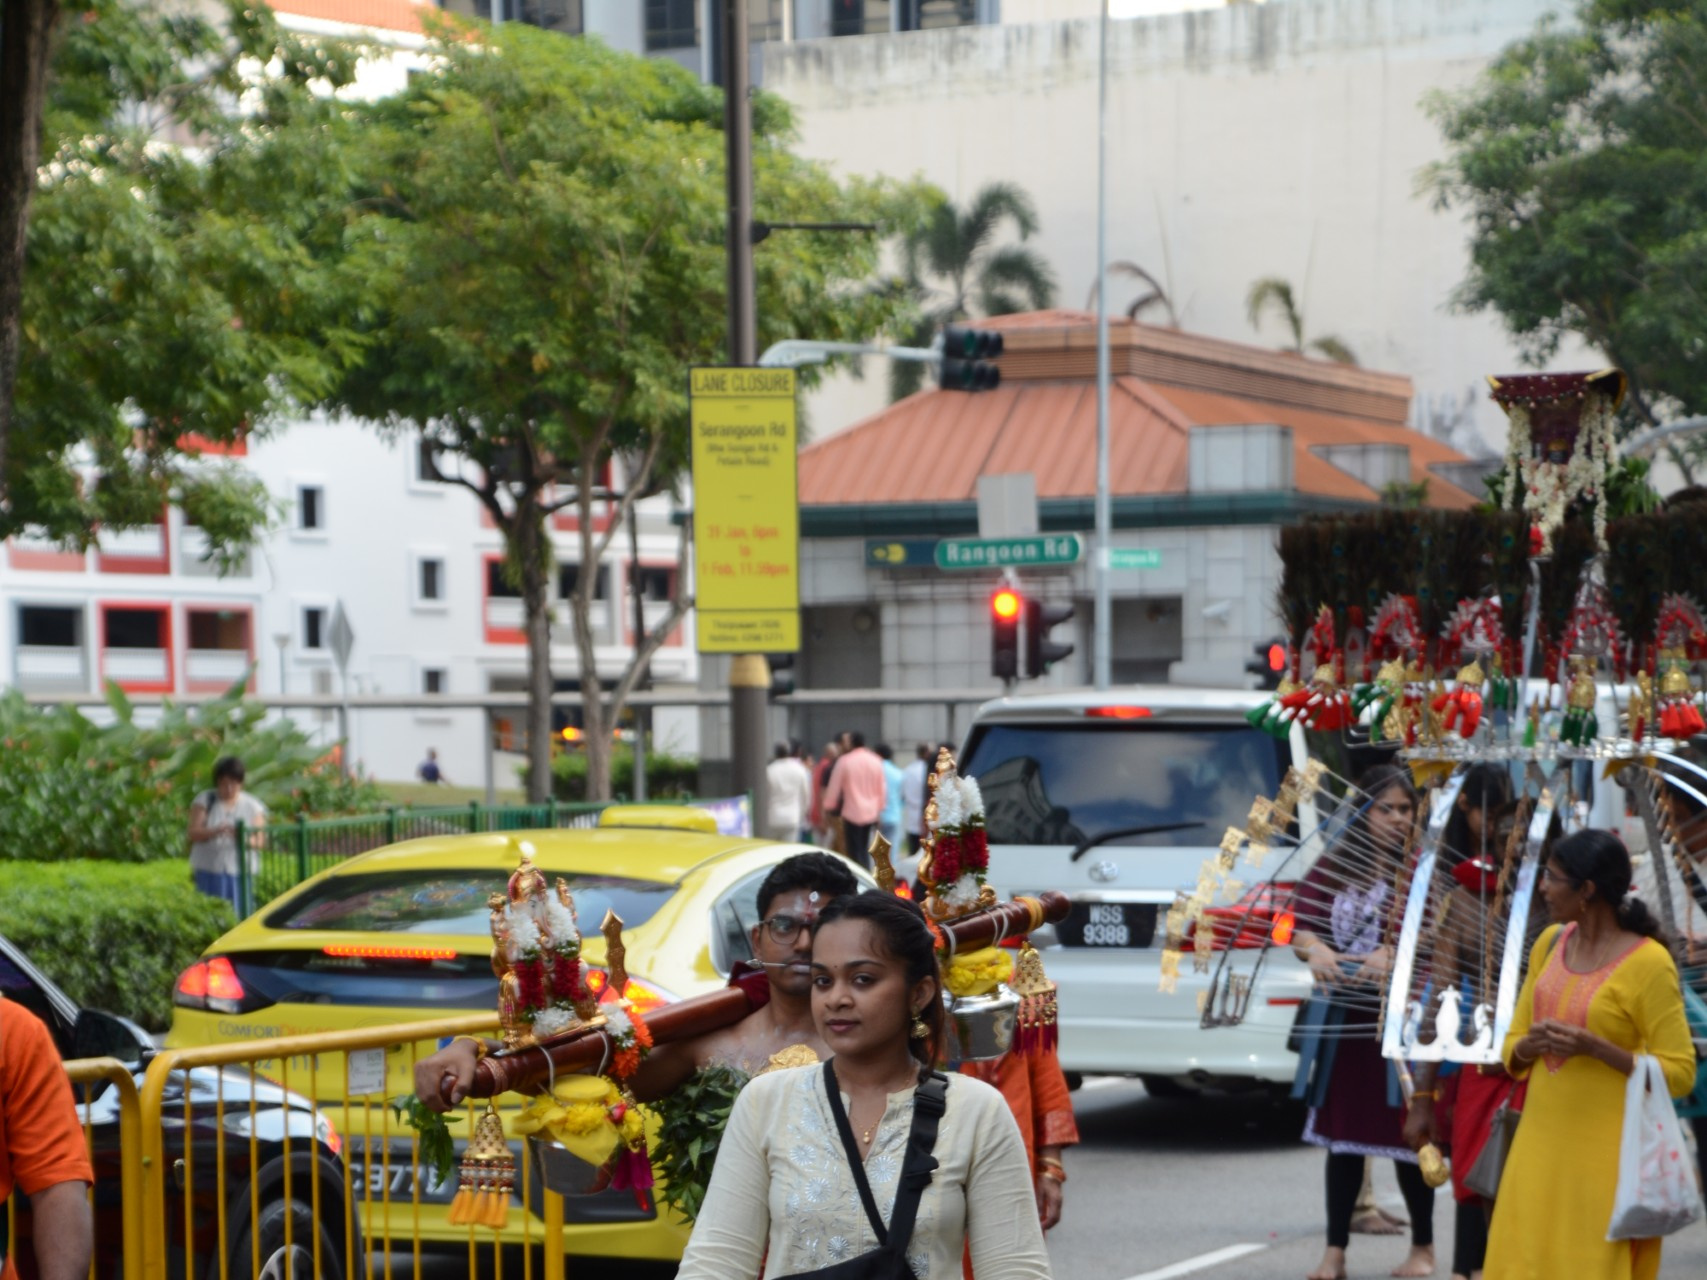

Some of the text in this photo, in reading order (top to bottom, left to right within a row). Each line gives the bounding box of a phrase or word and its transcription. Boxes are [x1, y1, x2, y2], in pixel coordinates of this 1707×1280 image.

[694, 372, 790, 392] LANE CLOSURE
[699, 420, 787, 440] Serangoon Rd
[946, 538, 1070, 564] Rangoon Rd
[1089, 905, 1123, 924] WSS
[1083, 924, 1129, 945] 9388
